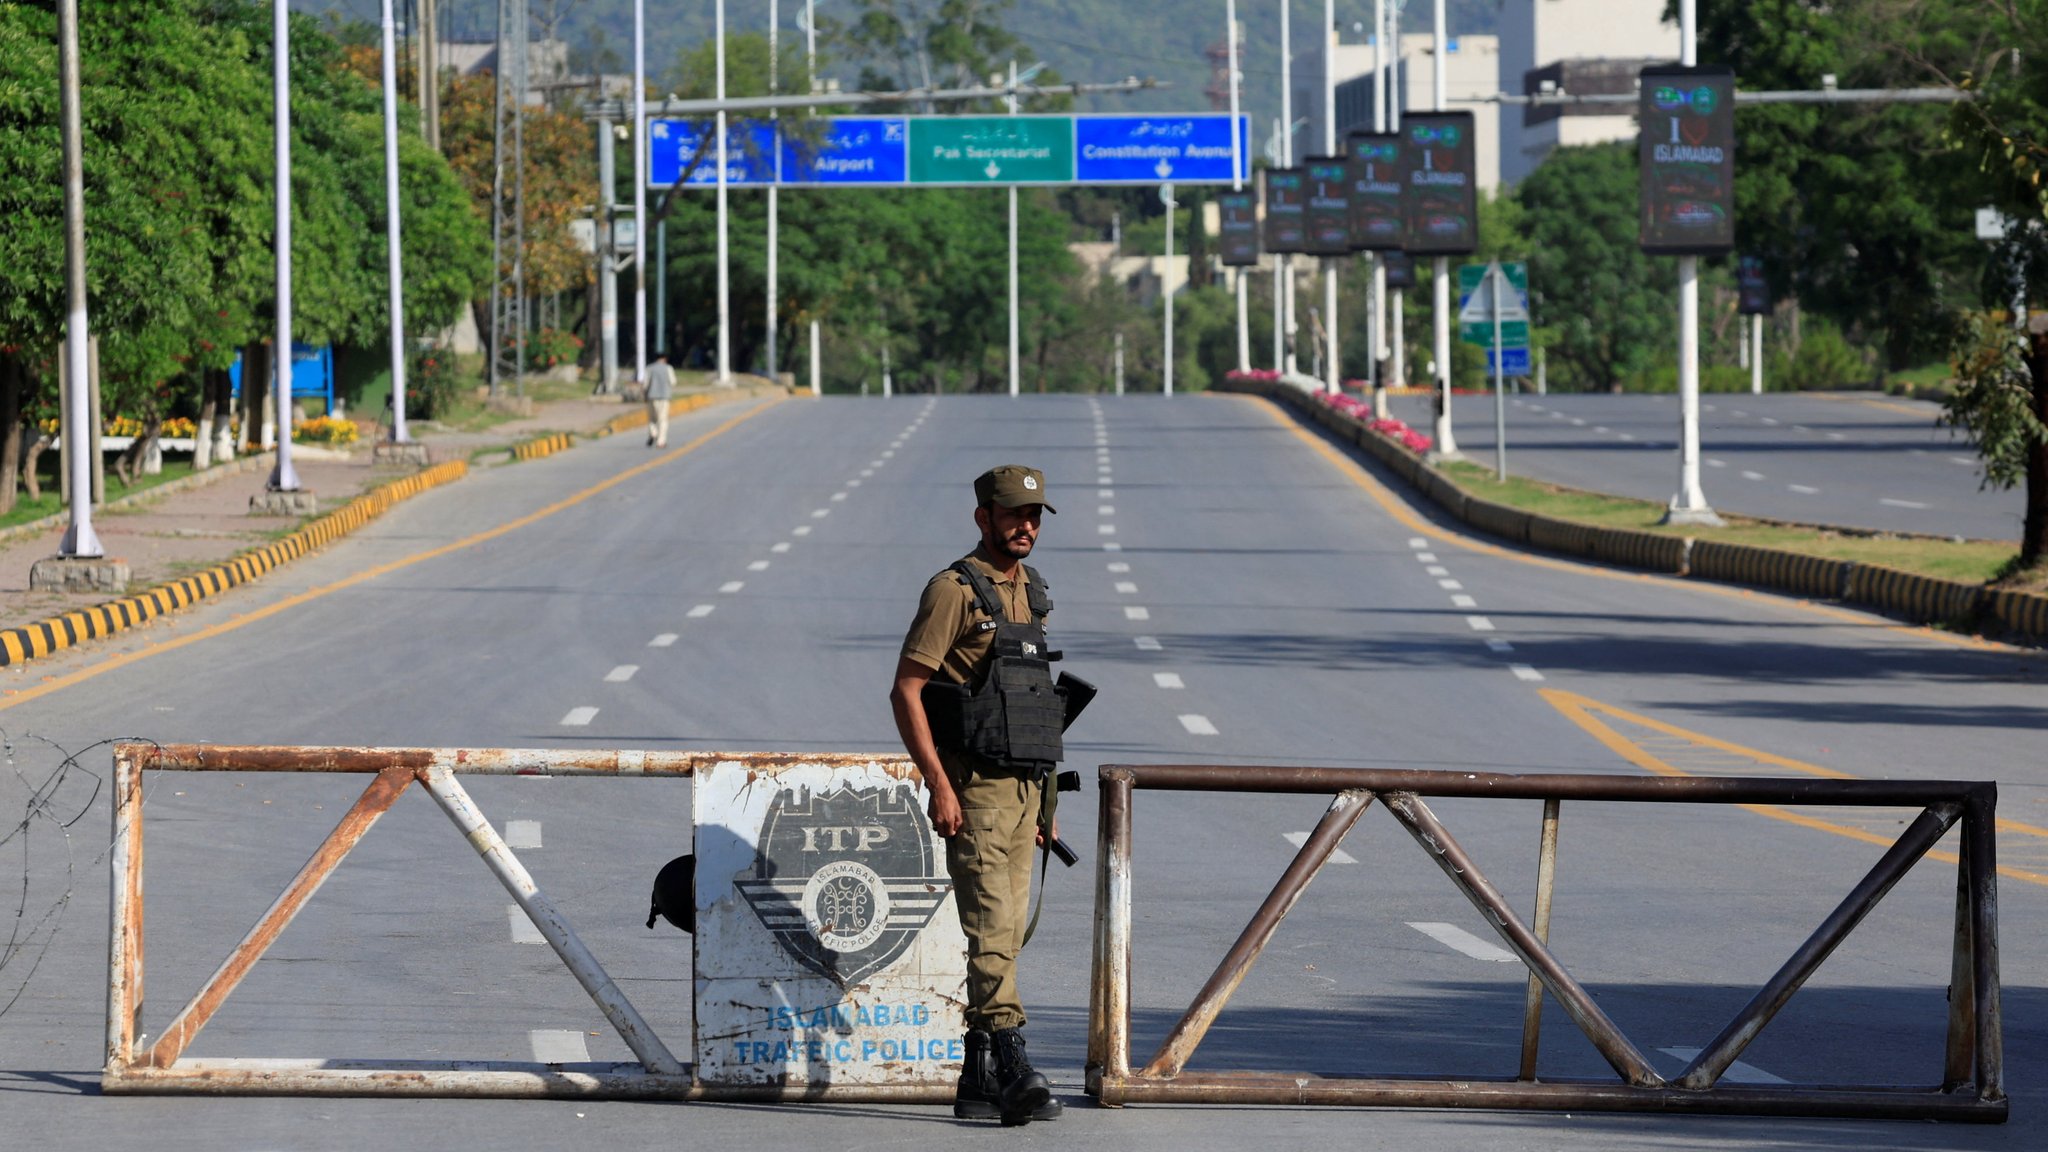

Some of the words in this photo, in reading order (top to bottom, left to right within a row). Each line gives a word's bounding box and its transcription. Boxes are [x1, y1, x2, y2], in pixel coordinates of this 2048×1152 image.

[934, 145, 961, 158] Pak
[1185, 144, 1233, 158] Avenu
[1654, 145, 1723, 163] ISLAMABAD
[815, 156, 874, 173] Airport
[801, 826, 890, 851] ITP
[816, 865, 876, 884] ISLAMABAD
[808, 917, 849, 949] TRFFIC
[850, 917, 883, 948] POLICE
[766, 1003, 930, 1030] ISLAMABAD
[734, 1039, 851, 1064] TRAFFIC
[862, 1038, 964, 1061] POLICE
